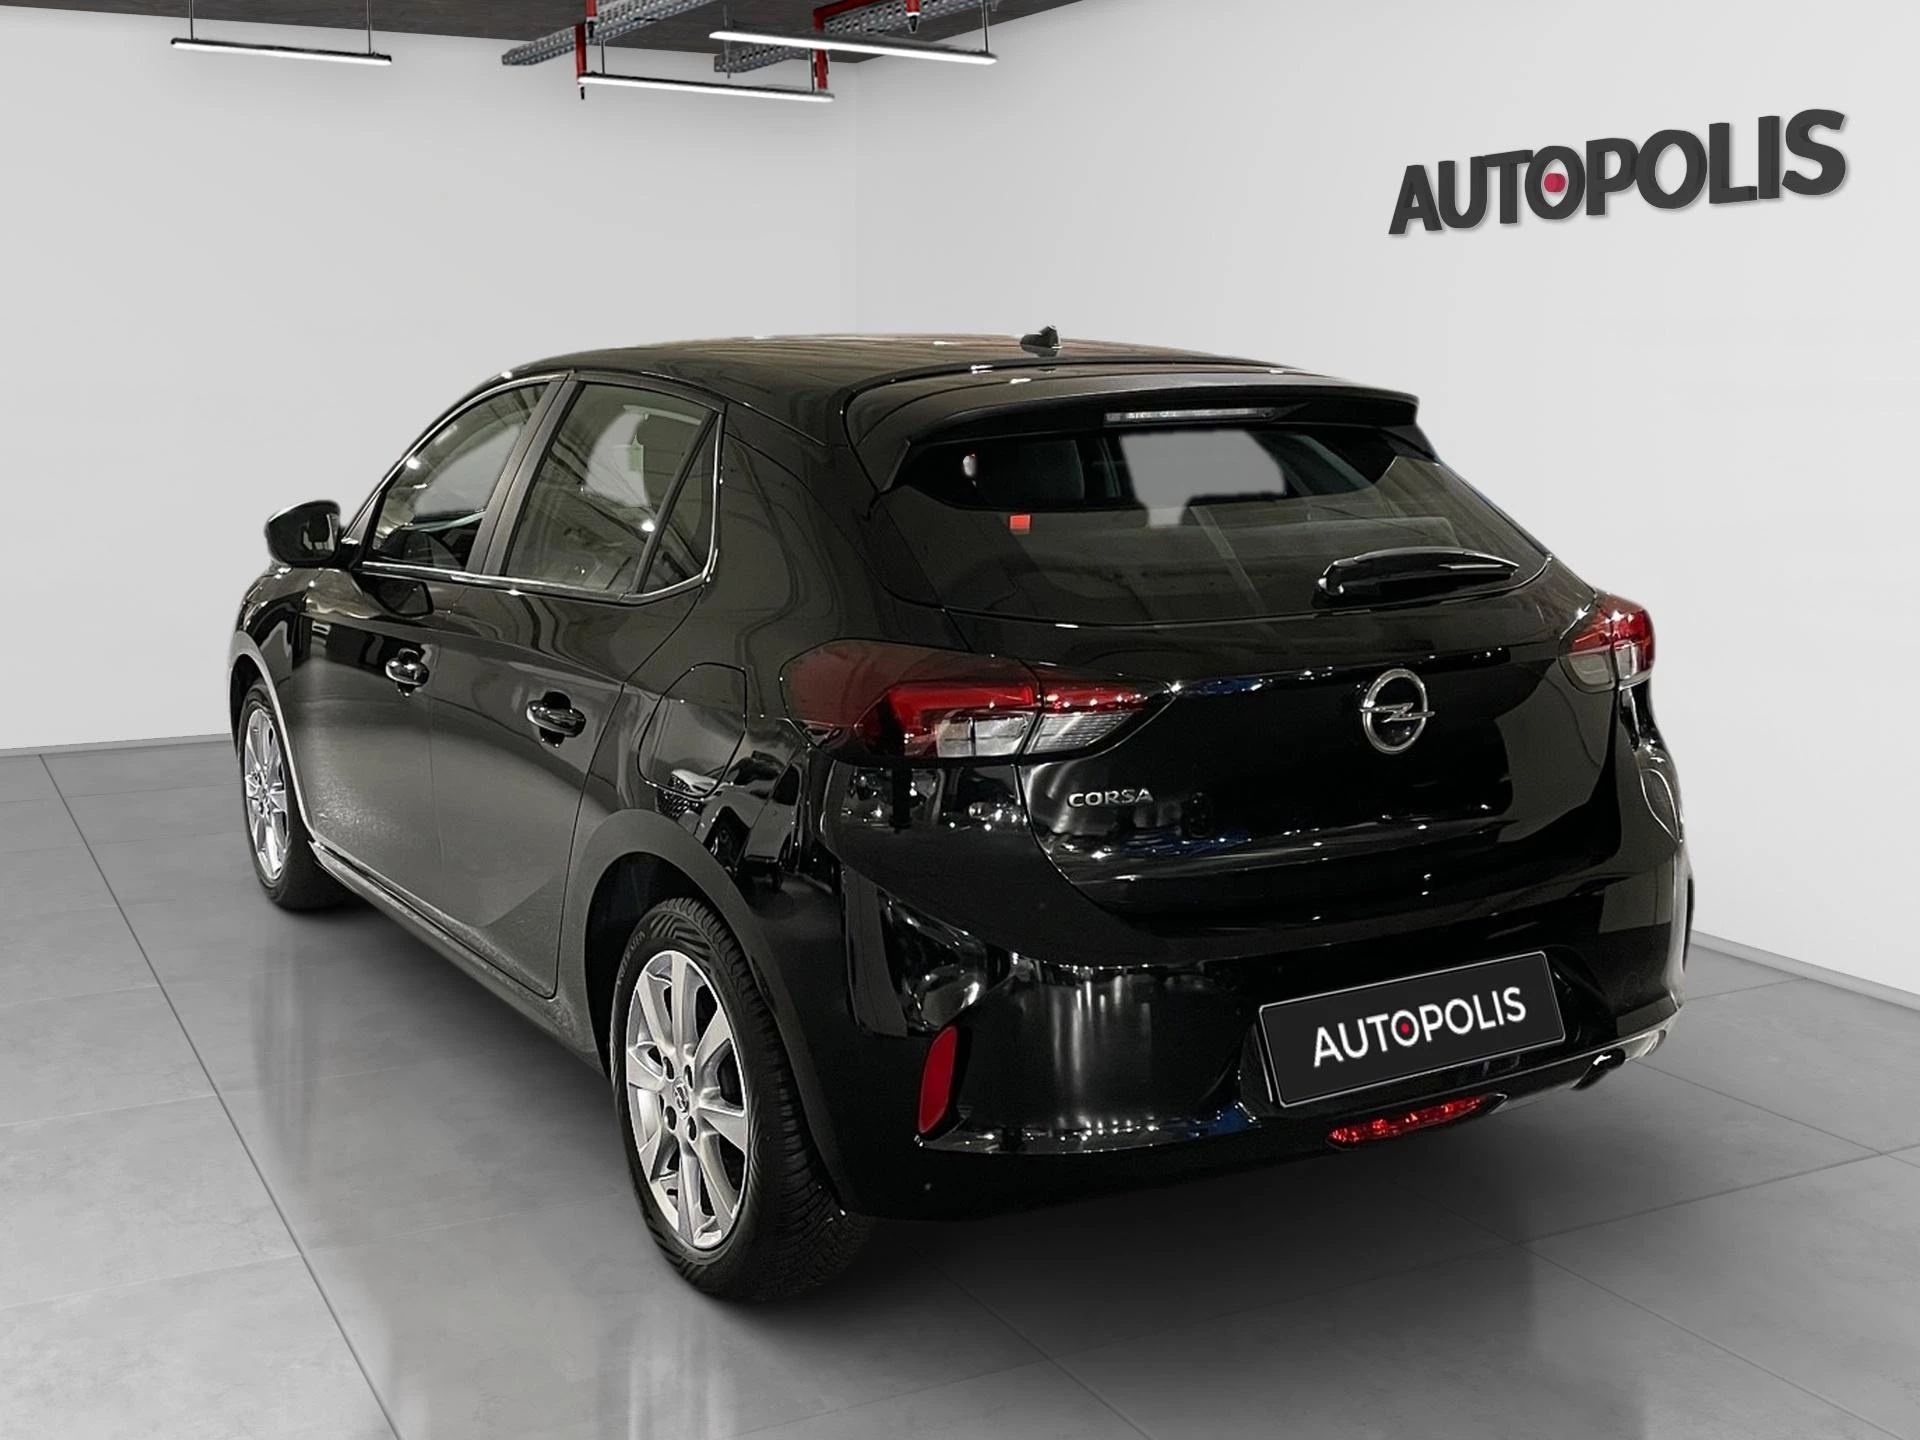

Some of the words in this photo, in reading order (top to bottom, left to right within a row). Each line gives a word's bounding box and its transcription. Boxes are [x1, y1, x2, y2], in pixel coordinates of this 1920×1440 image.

[1388, 108, 1847, 235] AUTOPOLIS
[1068, 788, 1154, 808] CORSA
[1313, 986, 1527, 1068] AUTOPOLIS
